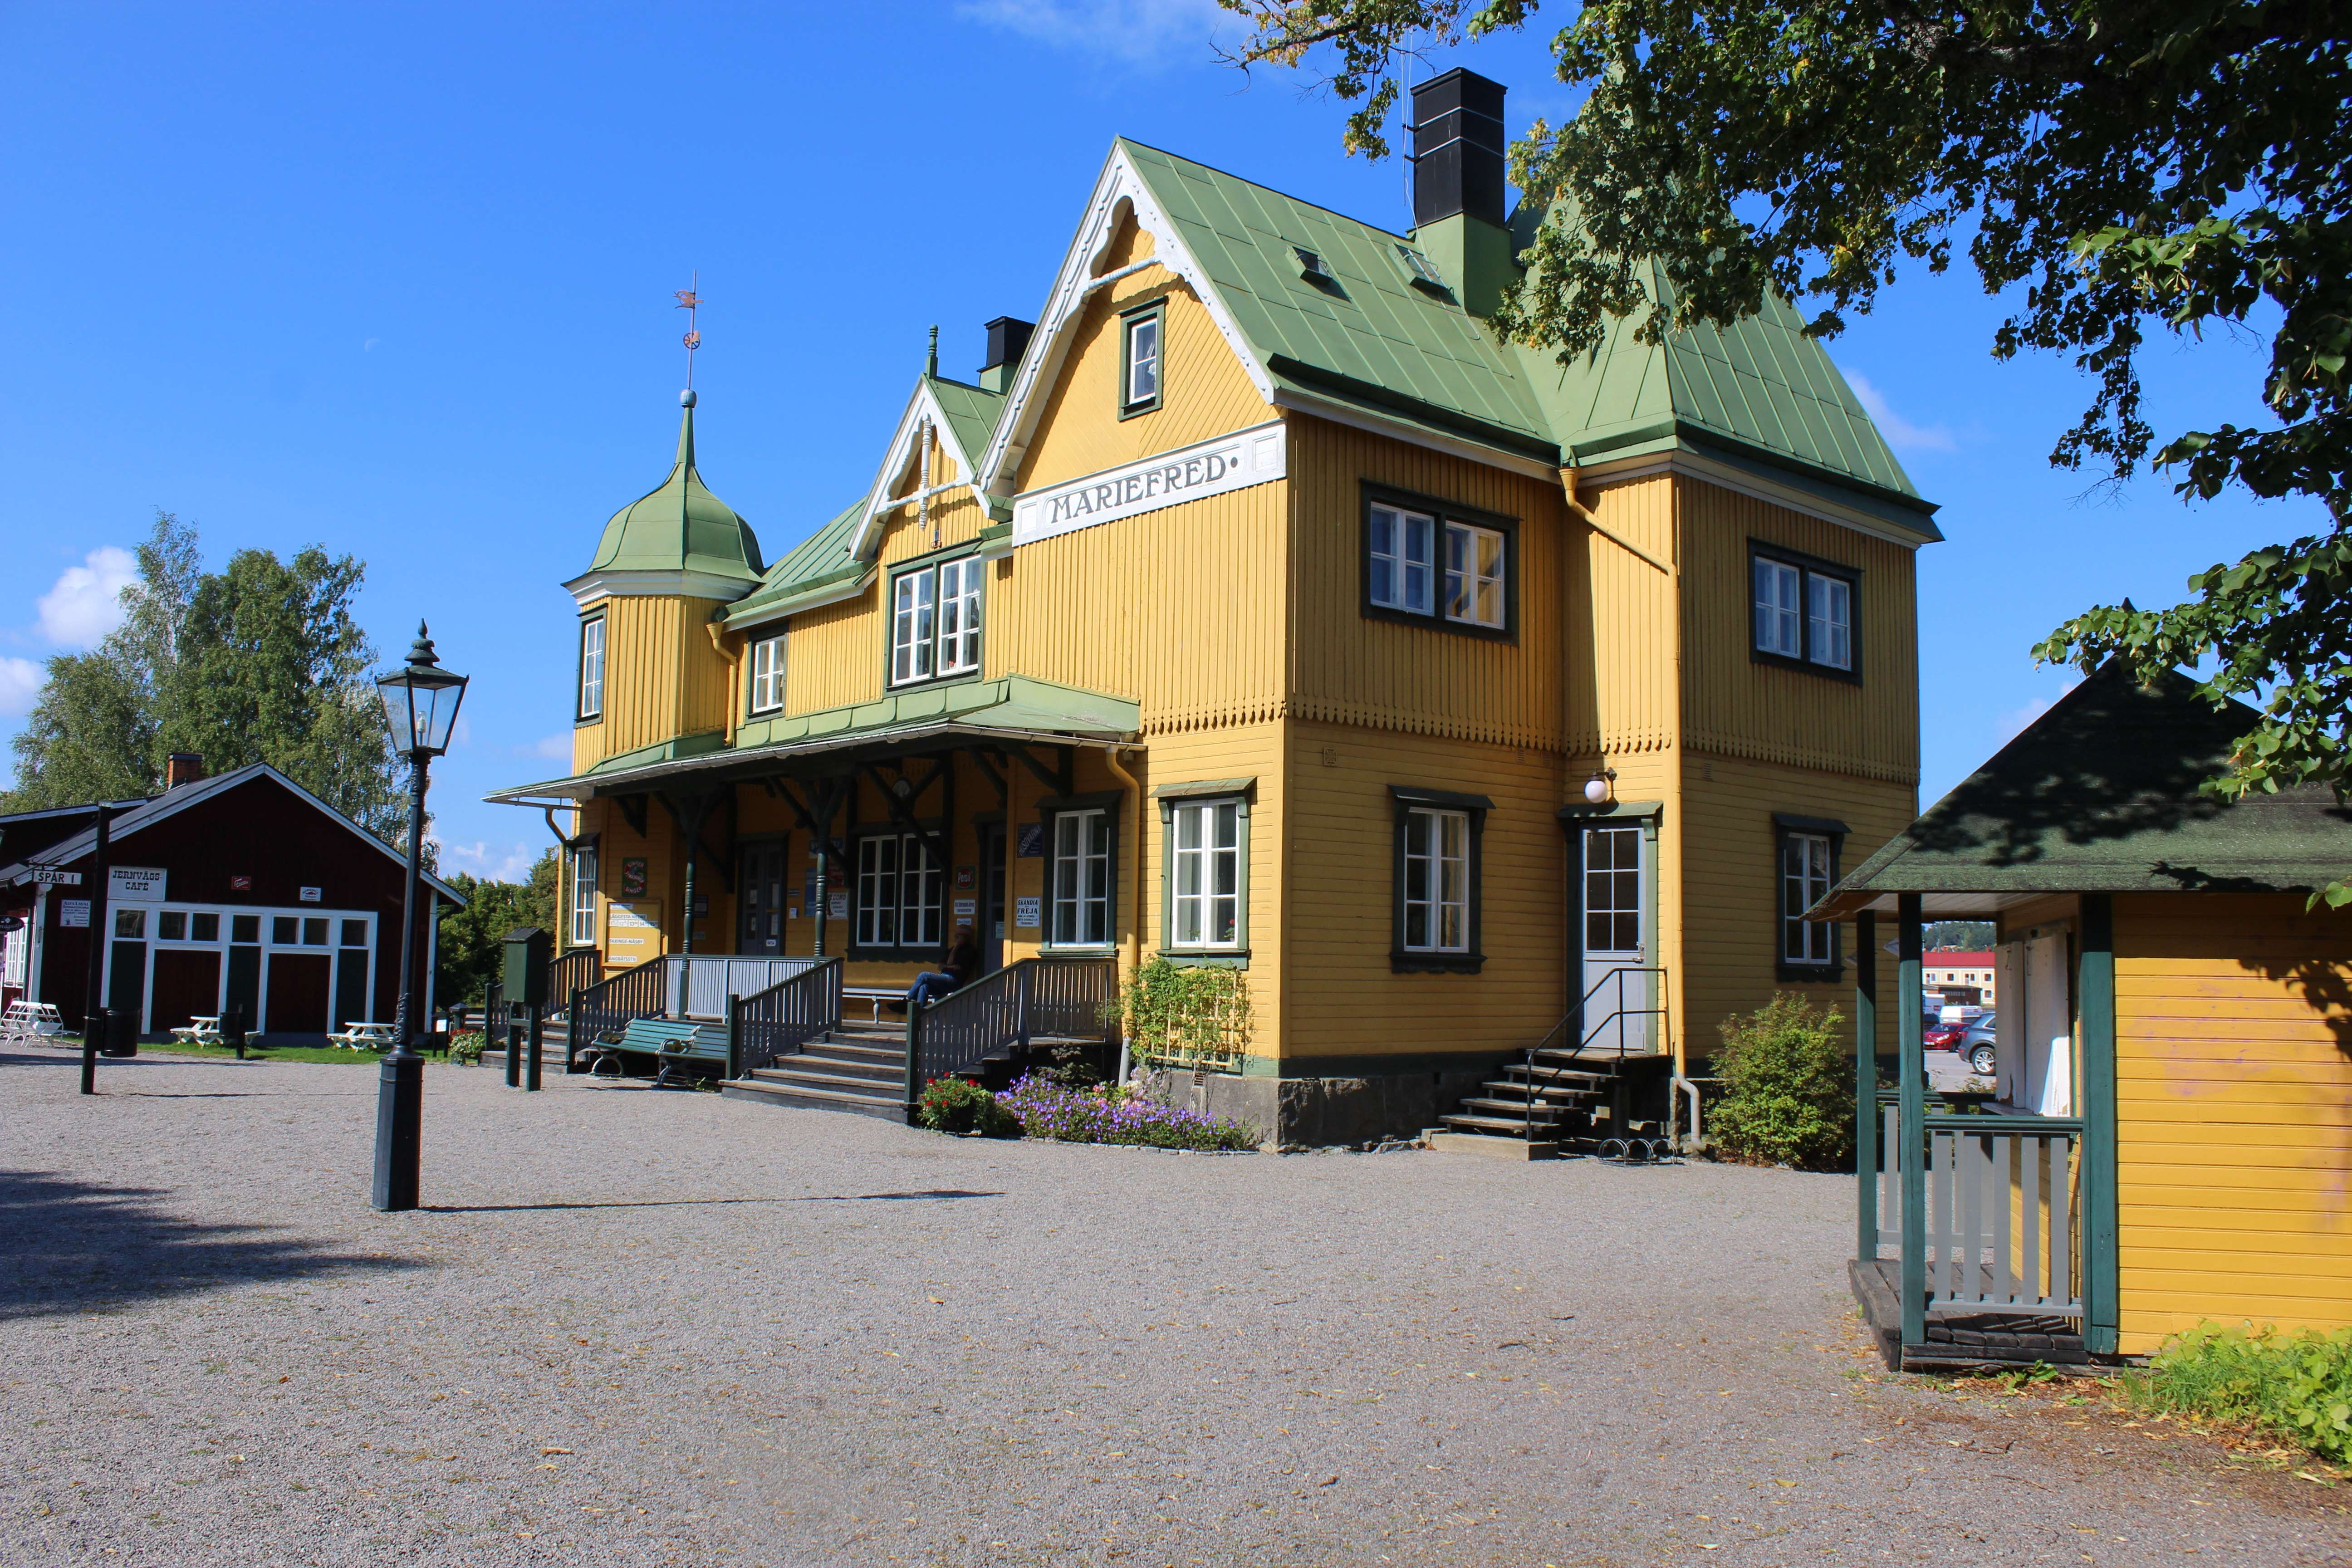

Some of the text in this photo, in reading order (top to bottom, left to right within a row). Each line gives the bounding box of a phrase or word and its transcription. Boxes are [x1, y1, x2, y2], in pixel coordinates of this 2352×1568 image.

[1051, 455, 1225, 523] MARIEFRED
[38, 871, 64, 883] SPÅR
[958, 872, 970, 883] Persil
[125, 882, 149, 891] CAFÉ
